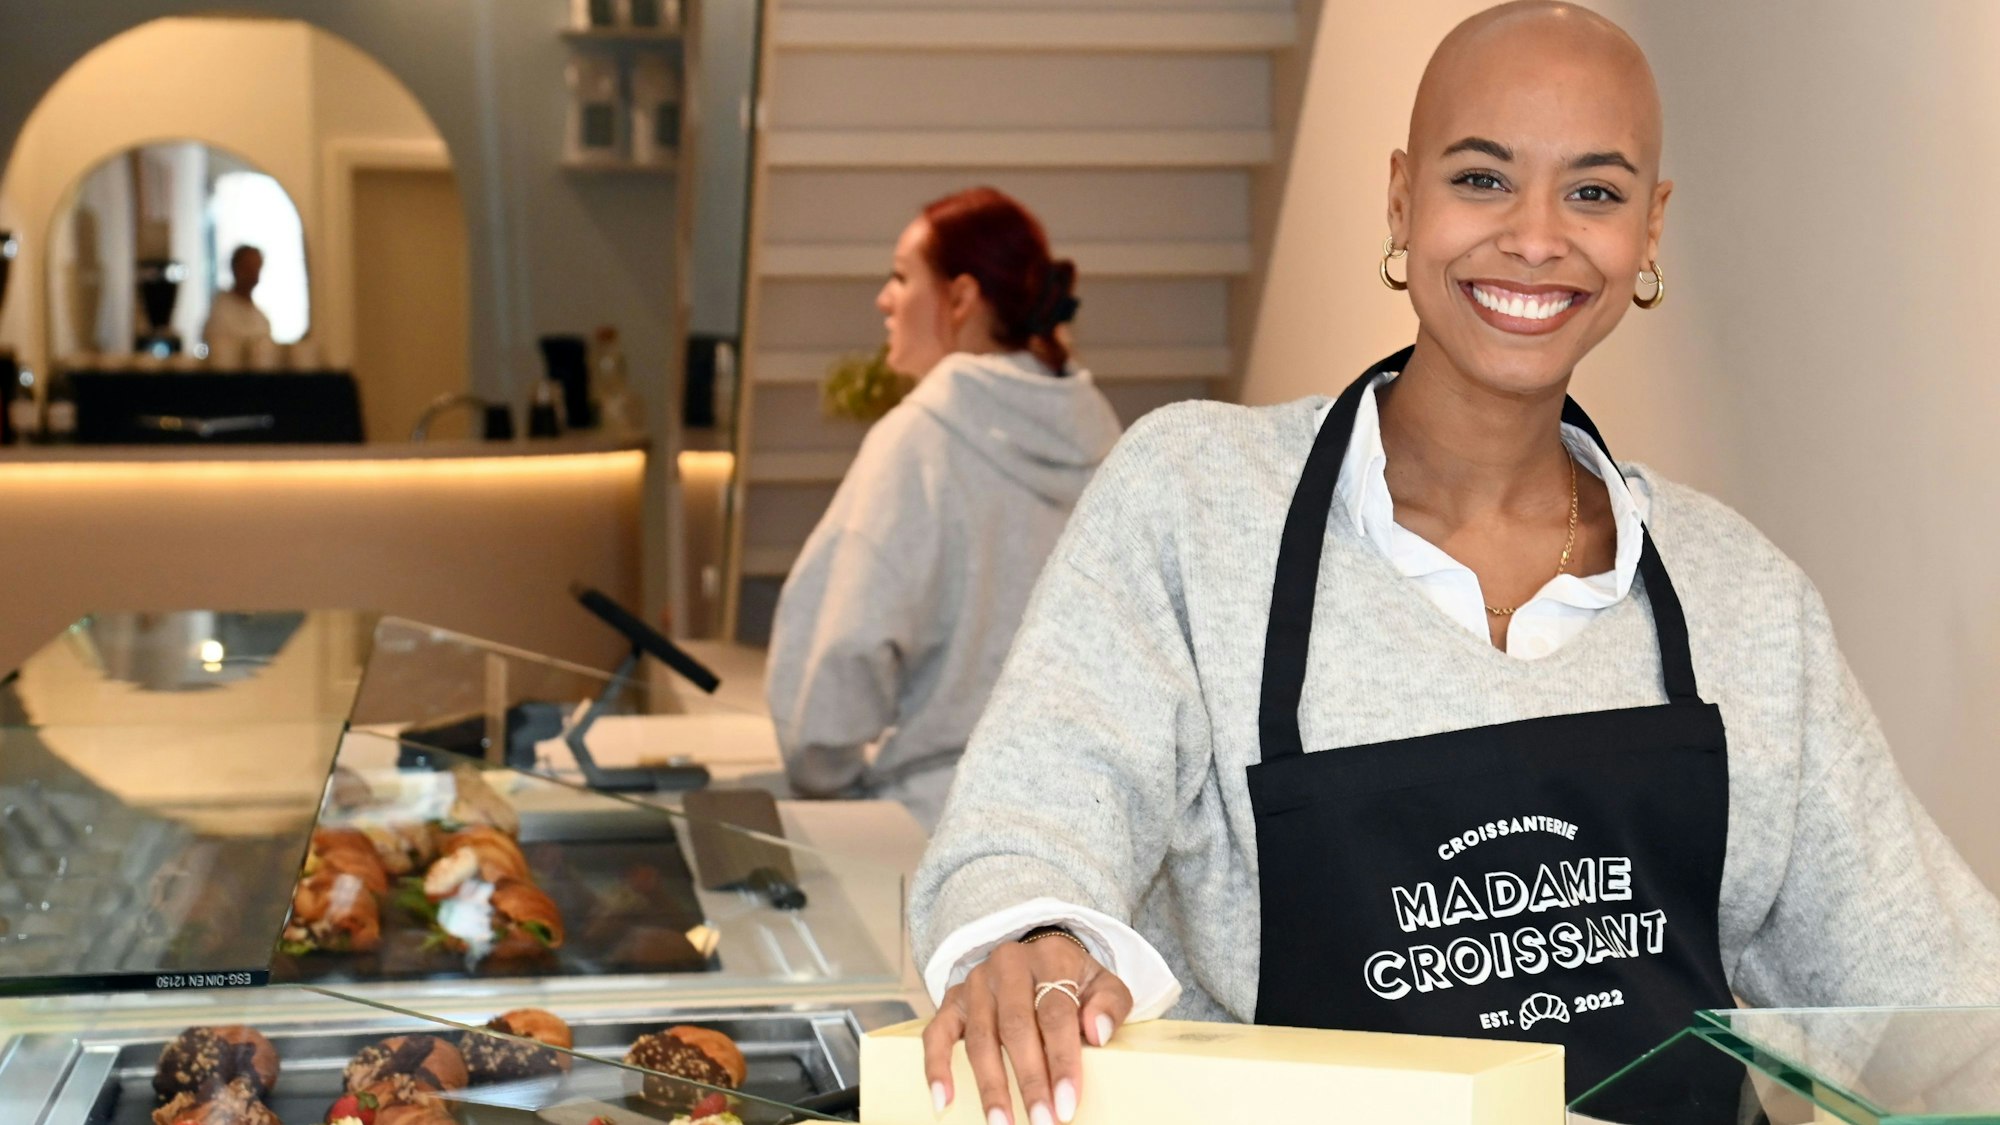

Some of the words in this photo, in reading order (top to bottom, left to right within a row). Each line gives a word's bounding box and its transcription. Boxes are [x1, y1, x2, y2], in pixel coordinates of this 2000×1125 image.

[1438, 815, 1578, 861] CROISSANTERIE
[1391, 856, 1633, 933] MADAME
[1363, 908, 1668, 1001] CROISSANT
[156, 976, 186, 988] 12150
[188, 975, 204, 987] EN
[205, 973, 251, 986] ESG-DIN
[1479, 1010, 1515, 1030] EST.
[1573, 988, 1625, 1014] 2022
